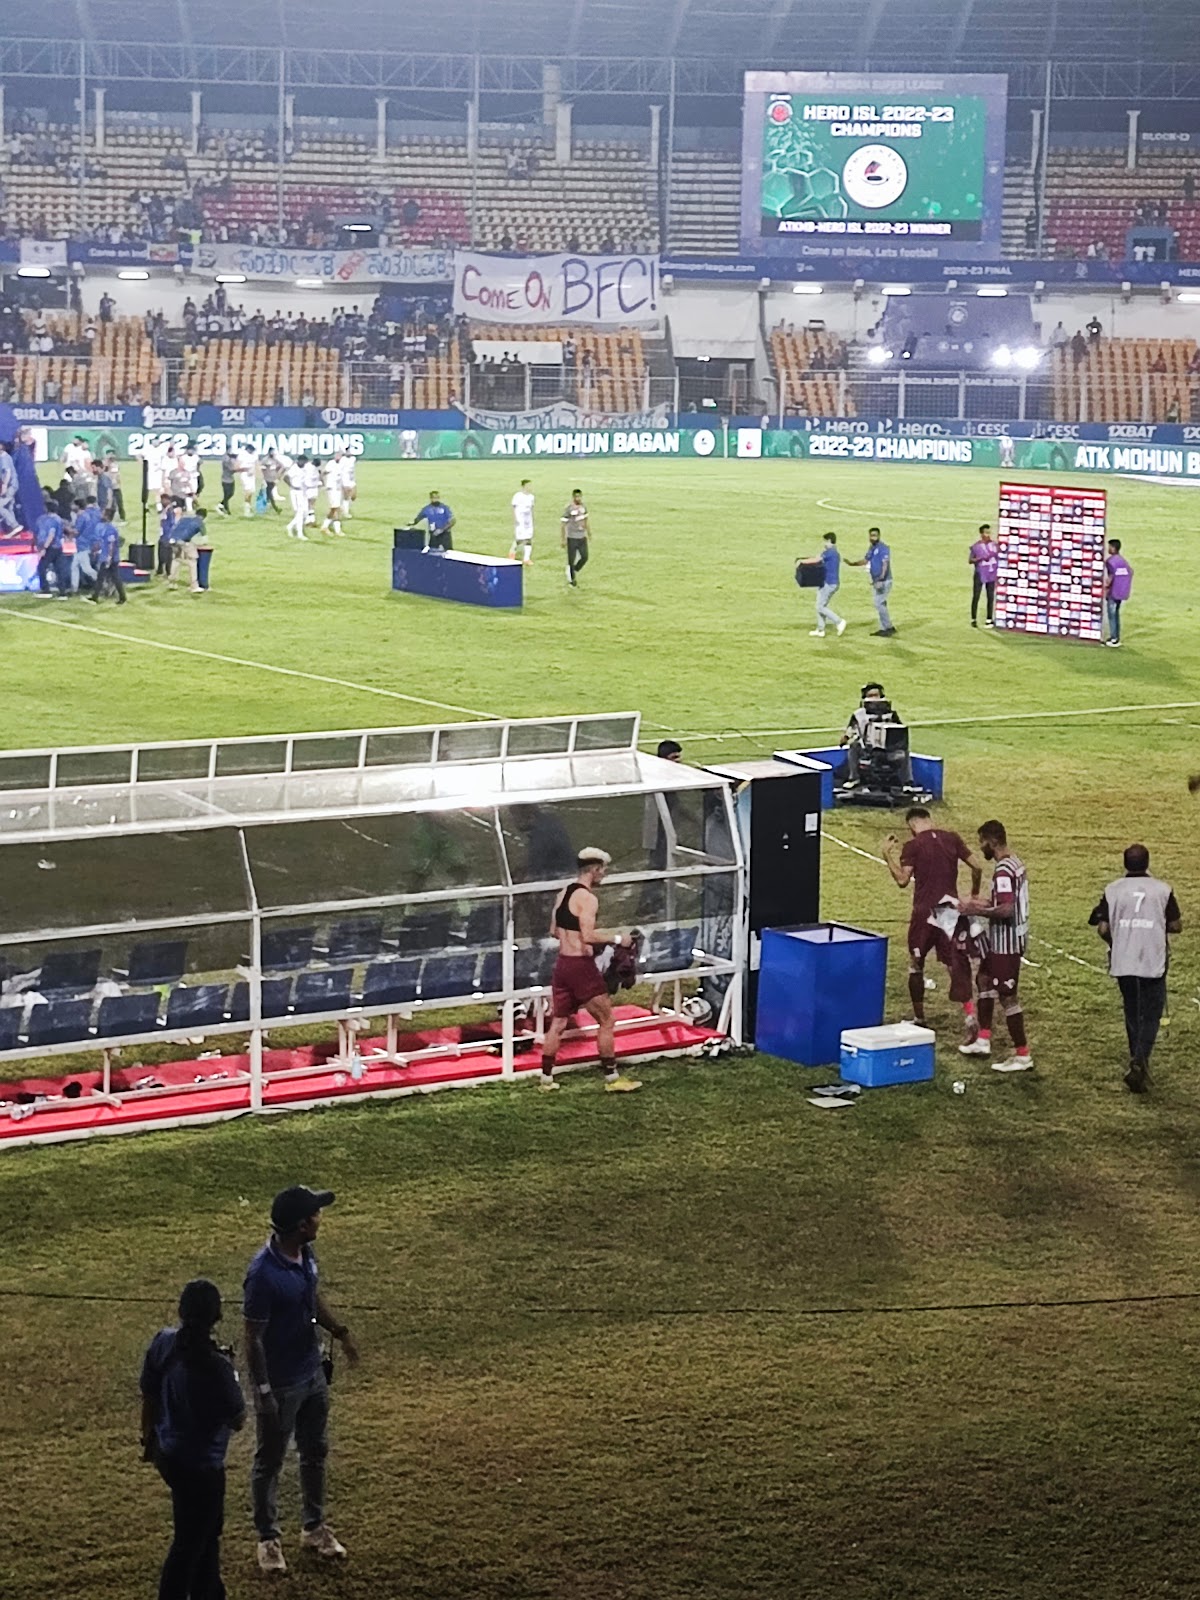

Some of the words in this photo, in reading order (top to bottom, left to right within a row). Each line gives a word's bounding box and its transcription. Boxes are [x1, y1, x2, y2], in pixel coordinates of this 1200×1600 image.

[803, 104, 850, 122] HERO
[853, 105, 880, 122] ISL
[882, 106, 955, 122] 2022-23
[830, 123, 922, 138] CHAMPIONS
[562, 257, 656, 319] BFC!
[61, 408, 125, 422] CEMENT
[149, 408, 196, 421] XBAT
[978, 423, 1010, 435] CESC
[1108, 424, 1157, 438] 1XBAT
[491, 433, 532, 455] ATK
[535, 432, 609, 454] MOHUN
[613, 431, 680, 453] BAGAN
[809, 434, 874, 458] 2022-23
[876, 437, 972, 462] CHAMPIONS
[1074, 445, 1111, 469] ATK
[1113, 447, 1183, 474] MOHUN
[1132, 891, 1146, 913] 7
